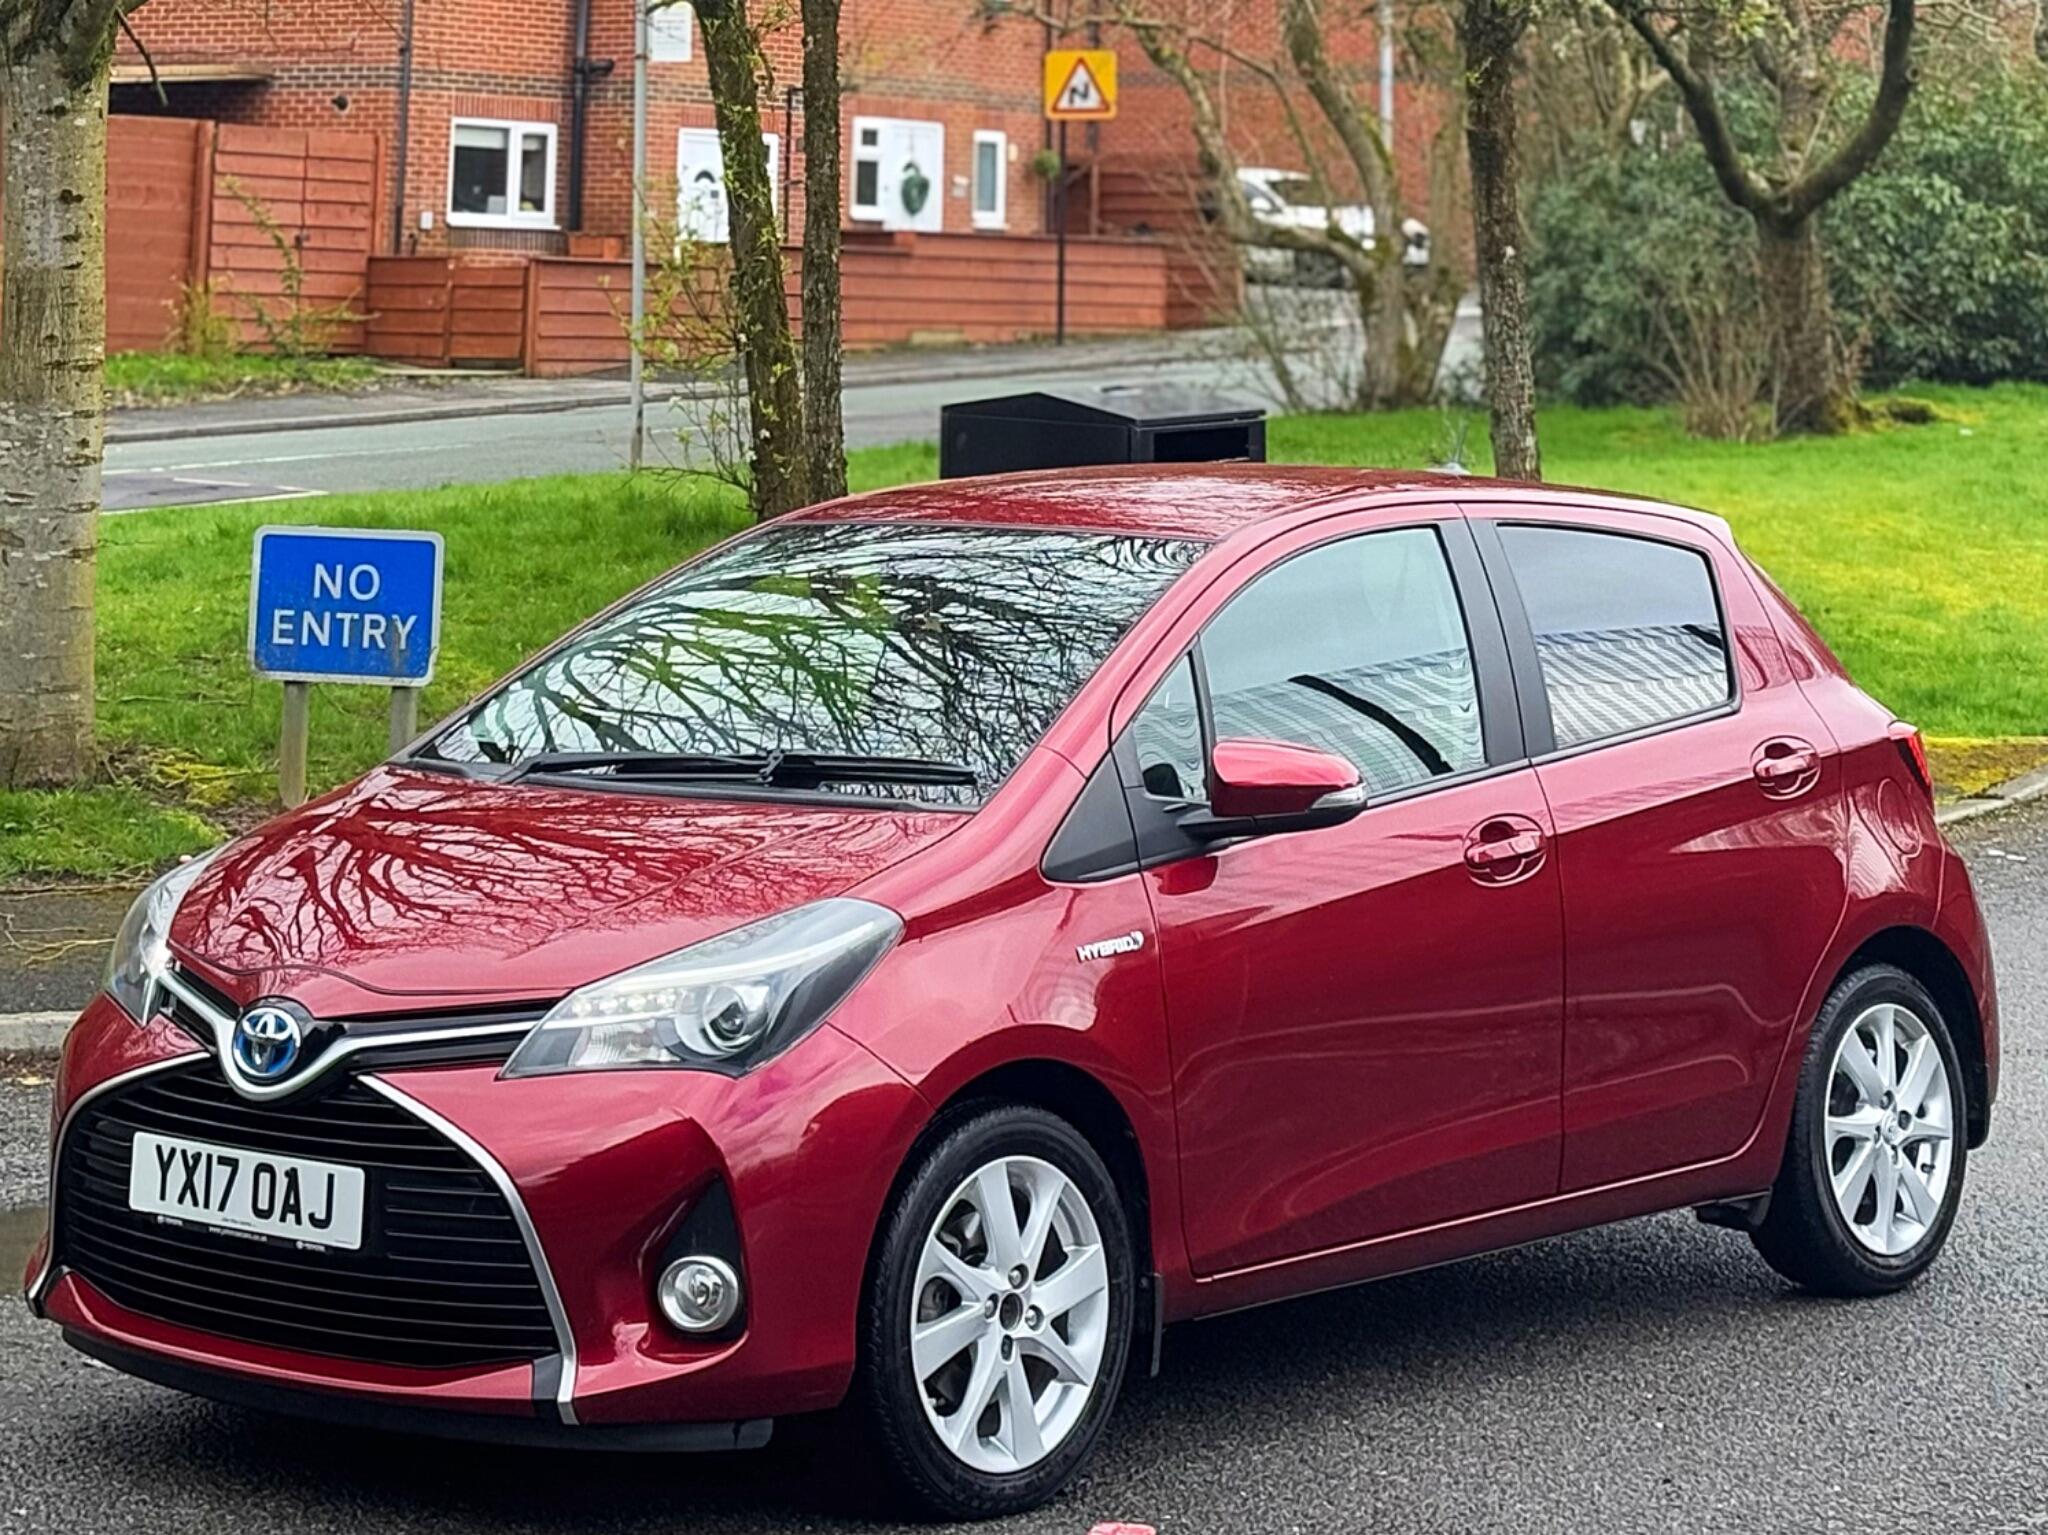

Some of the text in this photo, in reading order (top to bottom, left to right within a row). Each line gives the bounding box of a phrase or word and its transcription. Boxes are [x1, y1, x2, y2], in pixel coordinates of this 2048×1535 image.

[313, 563, 381, 601] NO
[272, 608, 418, 650] ENTRY
[1076, 935, 1134, 962] HYBRID
[155, 1143, 336, 1230] YX17 OAJ
